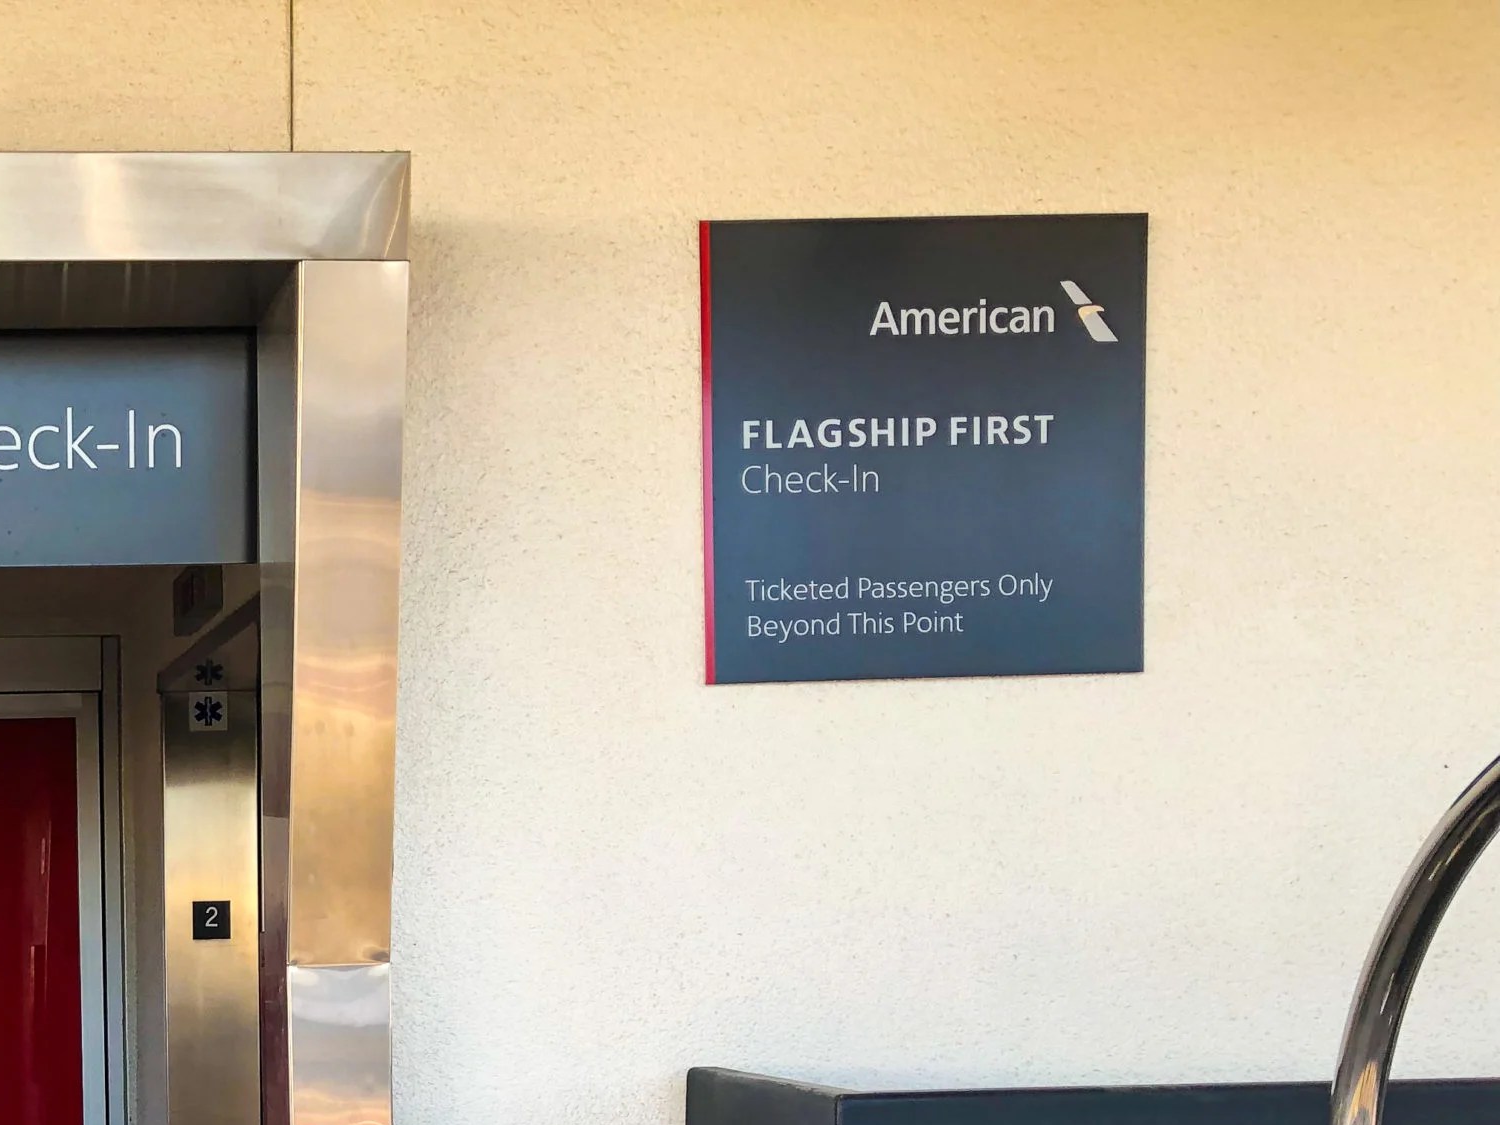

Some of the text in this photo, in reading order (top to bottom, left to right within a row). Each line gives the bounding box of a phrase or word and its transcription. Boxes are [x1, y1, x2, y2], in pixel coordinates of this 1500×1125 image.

[869, 298, 1055, 336] American
[742, 414, 1054, 450] FLAGSHIP FIRST
[741, 463, 880, 494] Check-In
[745, 573, 1054, 605] Ticketed Passengers Only
[747, 611, 964, 644] Beyond This Point
[205, 907, 218, 927] 2
